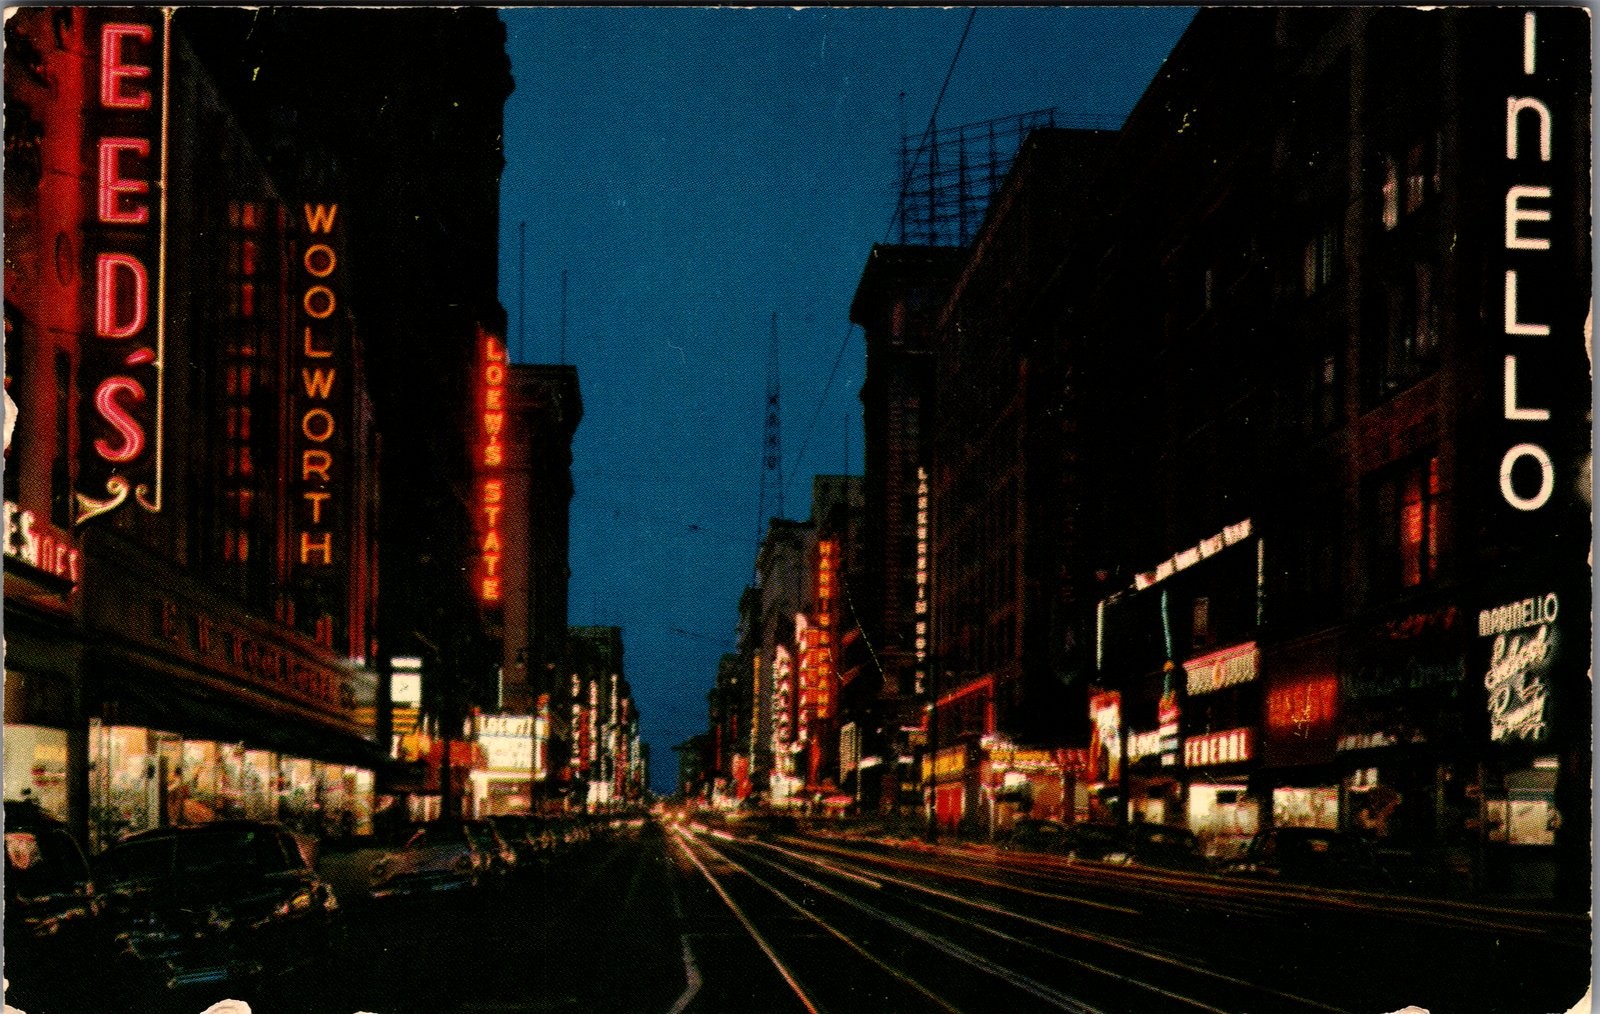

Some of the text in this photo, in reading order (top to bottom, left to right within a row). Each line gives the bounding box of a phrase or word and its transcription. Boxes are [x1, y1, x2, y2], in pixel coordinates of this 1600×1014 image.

[94, 22, 155, 464] EED'S
[301, 203, 338, 564] WOOLWORTH
[482, 336, 505, 601] LOEW'S STATE
